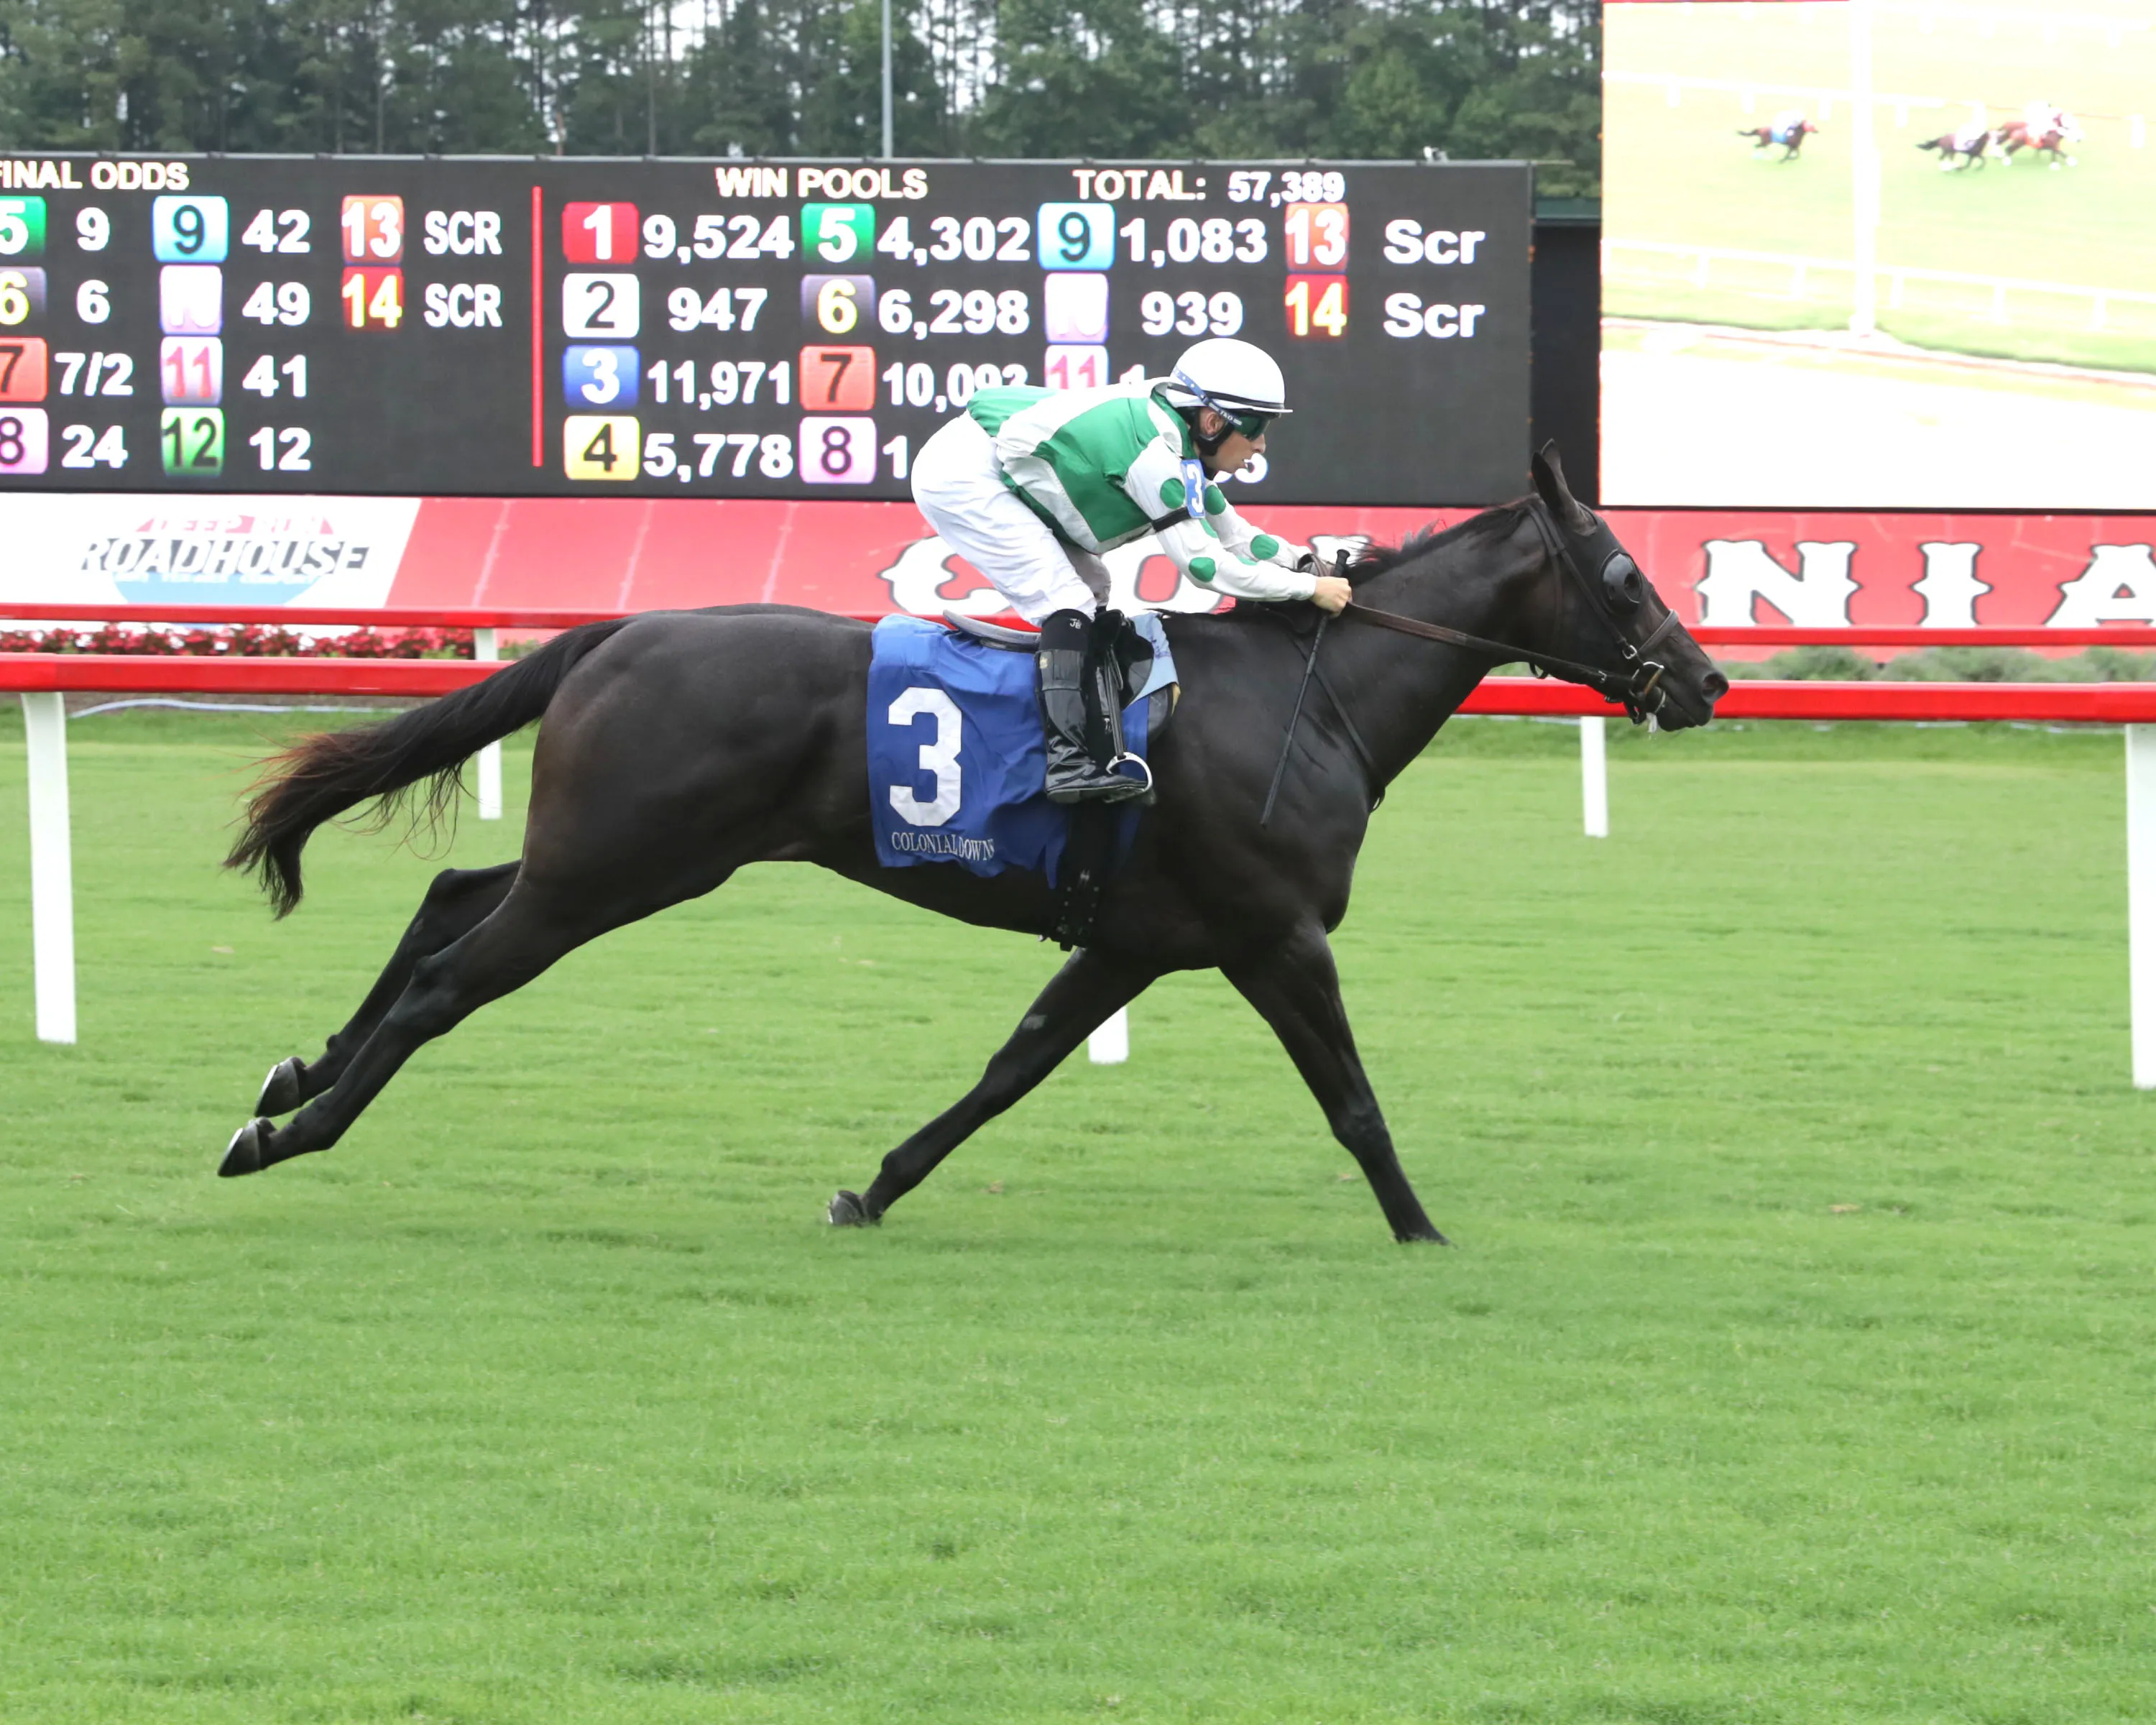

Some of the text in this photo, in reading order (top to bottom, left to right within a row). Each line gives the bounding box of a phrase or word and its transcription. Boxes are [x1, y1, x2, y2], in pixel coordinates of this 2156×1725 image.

[92, 162, 189, 190] ODDS
[716, 167, 1345, 208] WIN POOLS TOTAL: 57,389
[0, 201, 502, 257] 5 9 9 42 13 SCR
[583, 206, 1485, 267] 1 9,524 5 4,302 9 1,083 13 Scr
[0, 271, 29, 325] 6
[77, 280, 110, 323] 6
[242, 282, 310, 326] 49
[341, 274, 402, 328] 14
[424, 283, 502, 327] SCR
[584, 280, 615, 328] 2
[668, 288, 767, 331] 947
[817, 280, 858, 334] 6
[879, 289, 1029, 340] 6,298
[1141, 291, 1243, 336] 939
[1286, 282, 1346, 336] 14
[1384, 293, 1485, 338] Scr
[0, 345, 305, 397] 7 7/2 11 41
[581, 348, 619, 404] 3
[648, 360, 789, 410] 11,971
[819, 354, 852, 402] 7
[1050, 354, 1097, 389] 11
[0, 417, 310, 470] 8 24 12 12
[583, 423, 617, 472] 4
[643, 433, 793, 482] 5,778
[820, 426, 852, 475] 8
[1187, 463, 1204, 513] 3
[76, 536, 375, 576] ROADHOUSE
[888, 686, 962, 827] 3
[891, 831, 958, 856] COLONIAL
